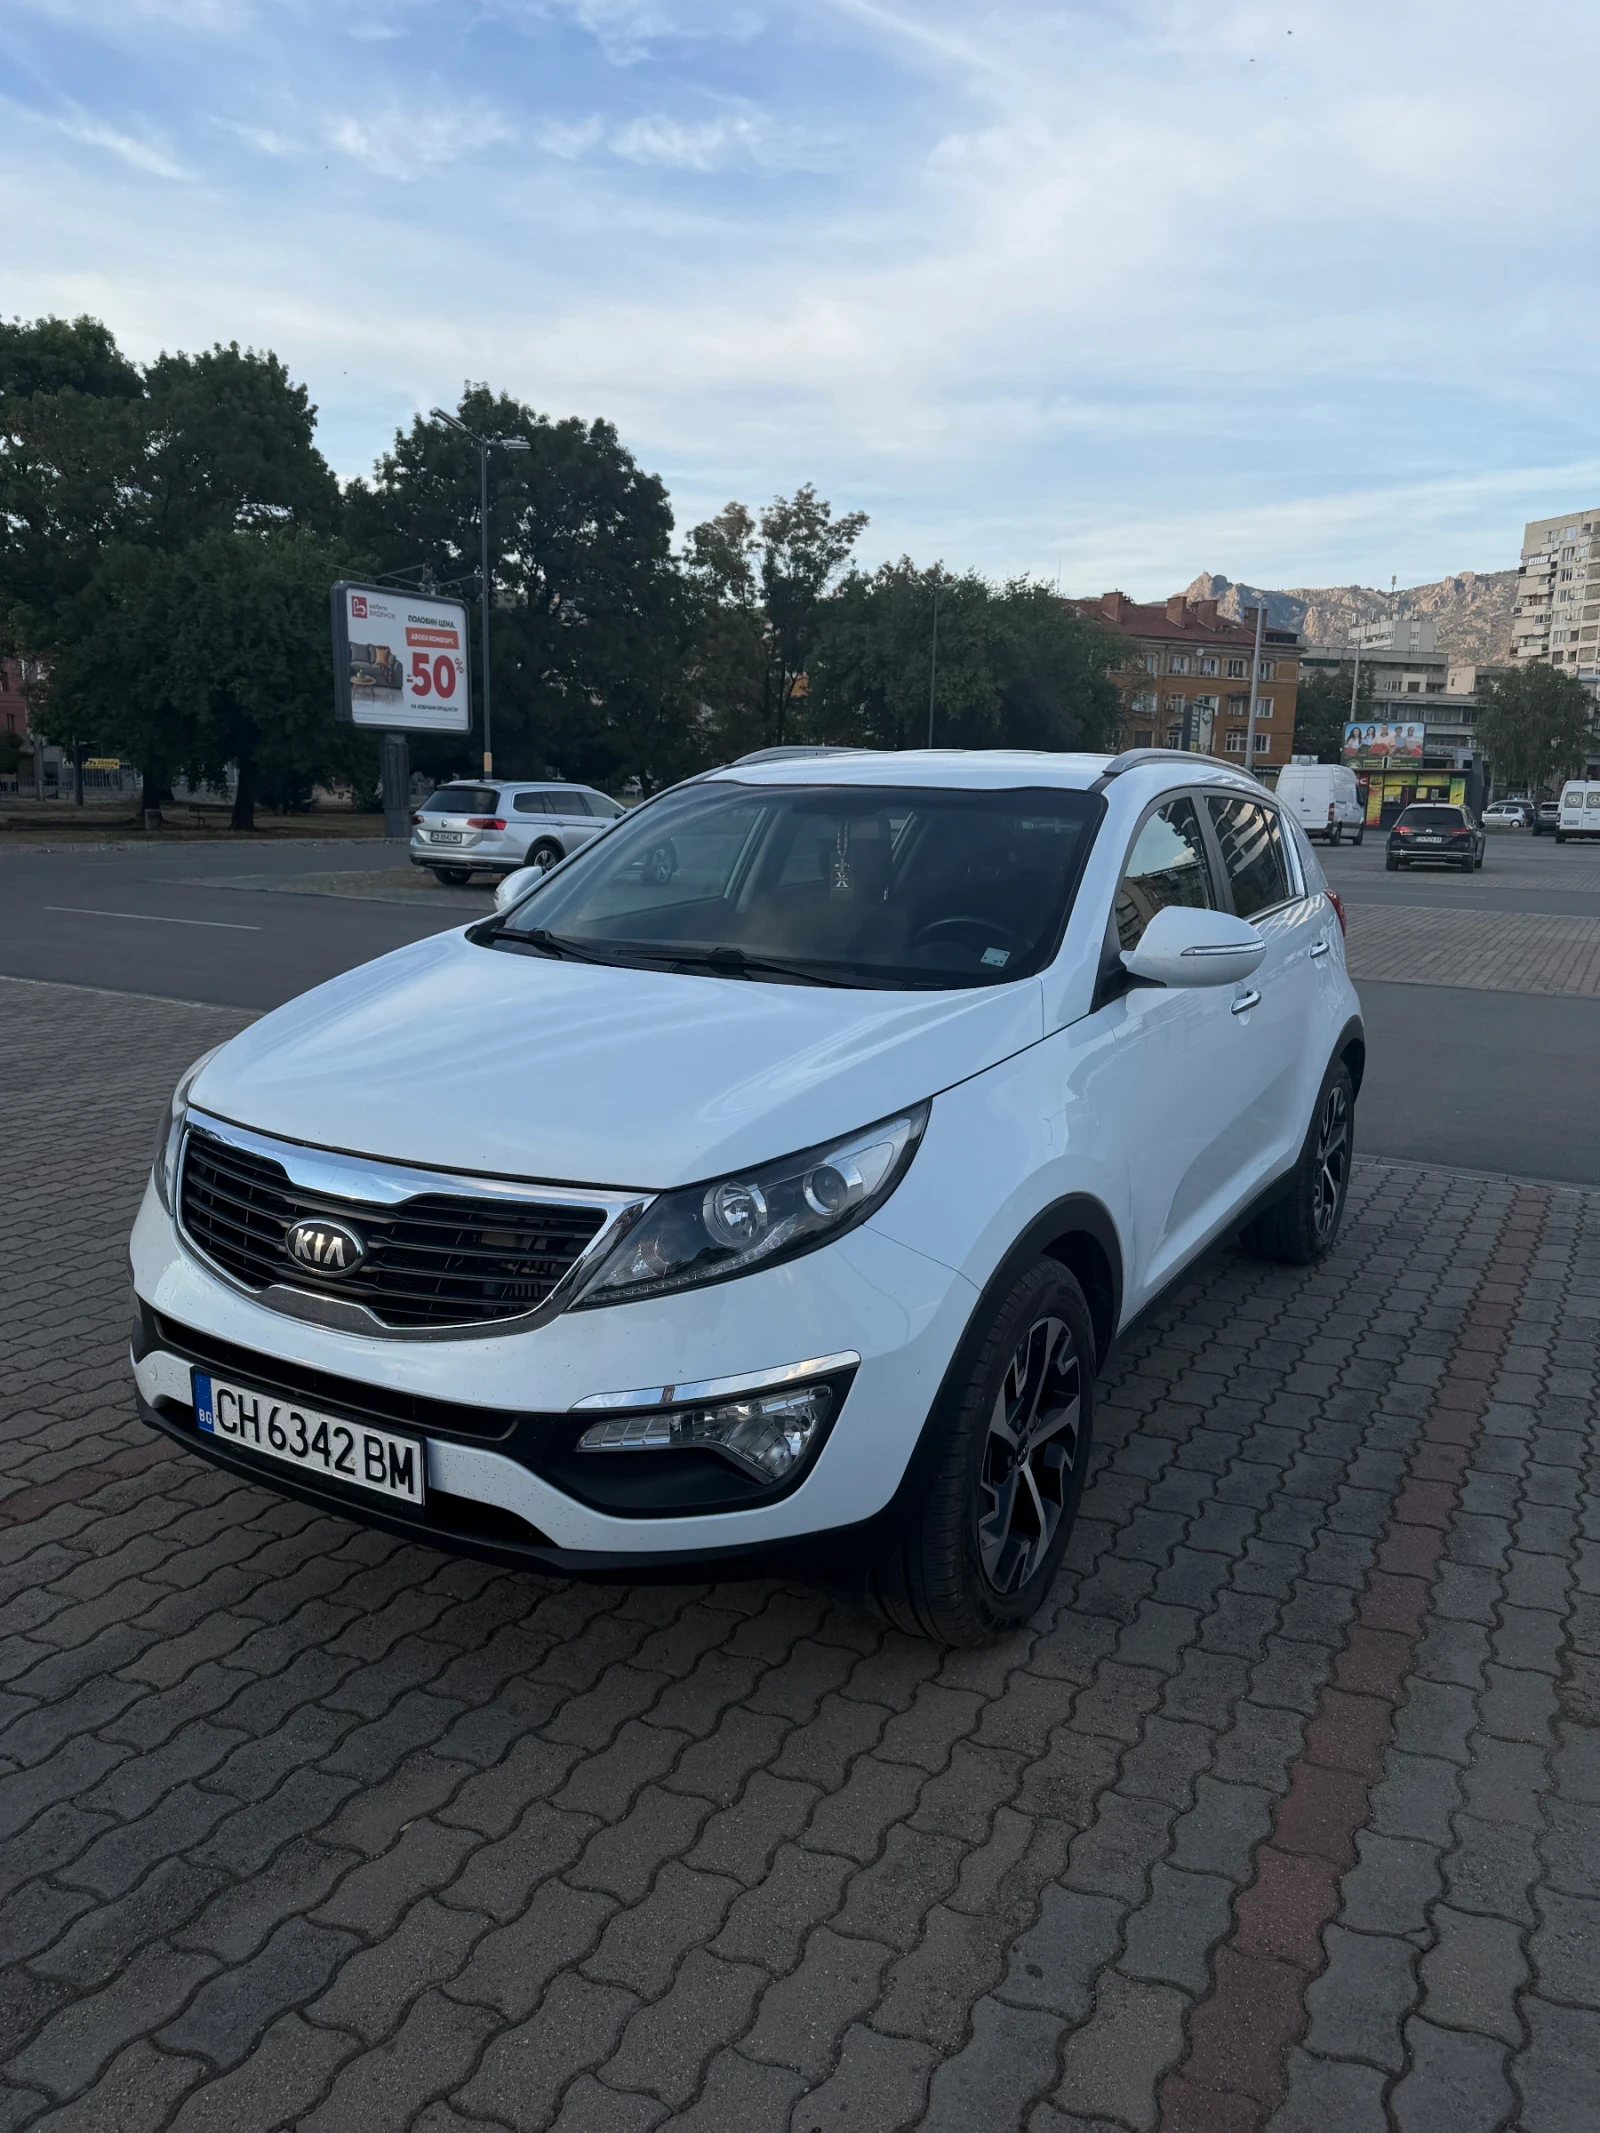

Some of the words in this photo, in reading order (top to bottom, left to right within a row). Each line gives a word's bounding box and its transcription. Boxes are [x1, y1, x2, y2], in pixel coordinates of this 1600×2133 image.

[408, 614, 438, 626] ПОЛОВИН
[438, 619, 456, 629] ЦЕНА.
[411, 633, 429, 641] ДВОЕН
[294, 1228, 346, 1267] KIA
[198, 1408, 212, 1425] BG
[217, 1388, 260, 1443] CH
[268, 1405, 355, 1476] 6342
[363, 1432, 414, 1495] BM
